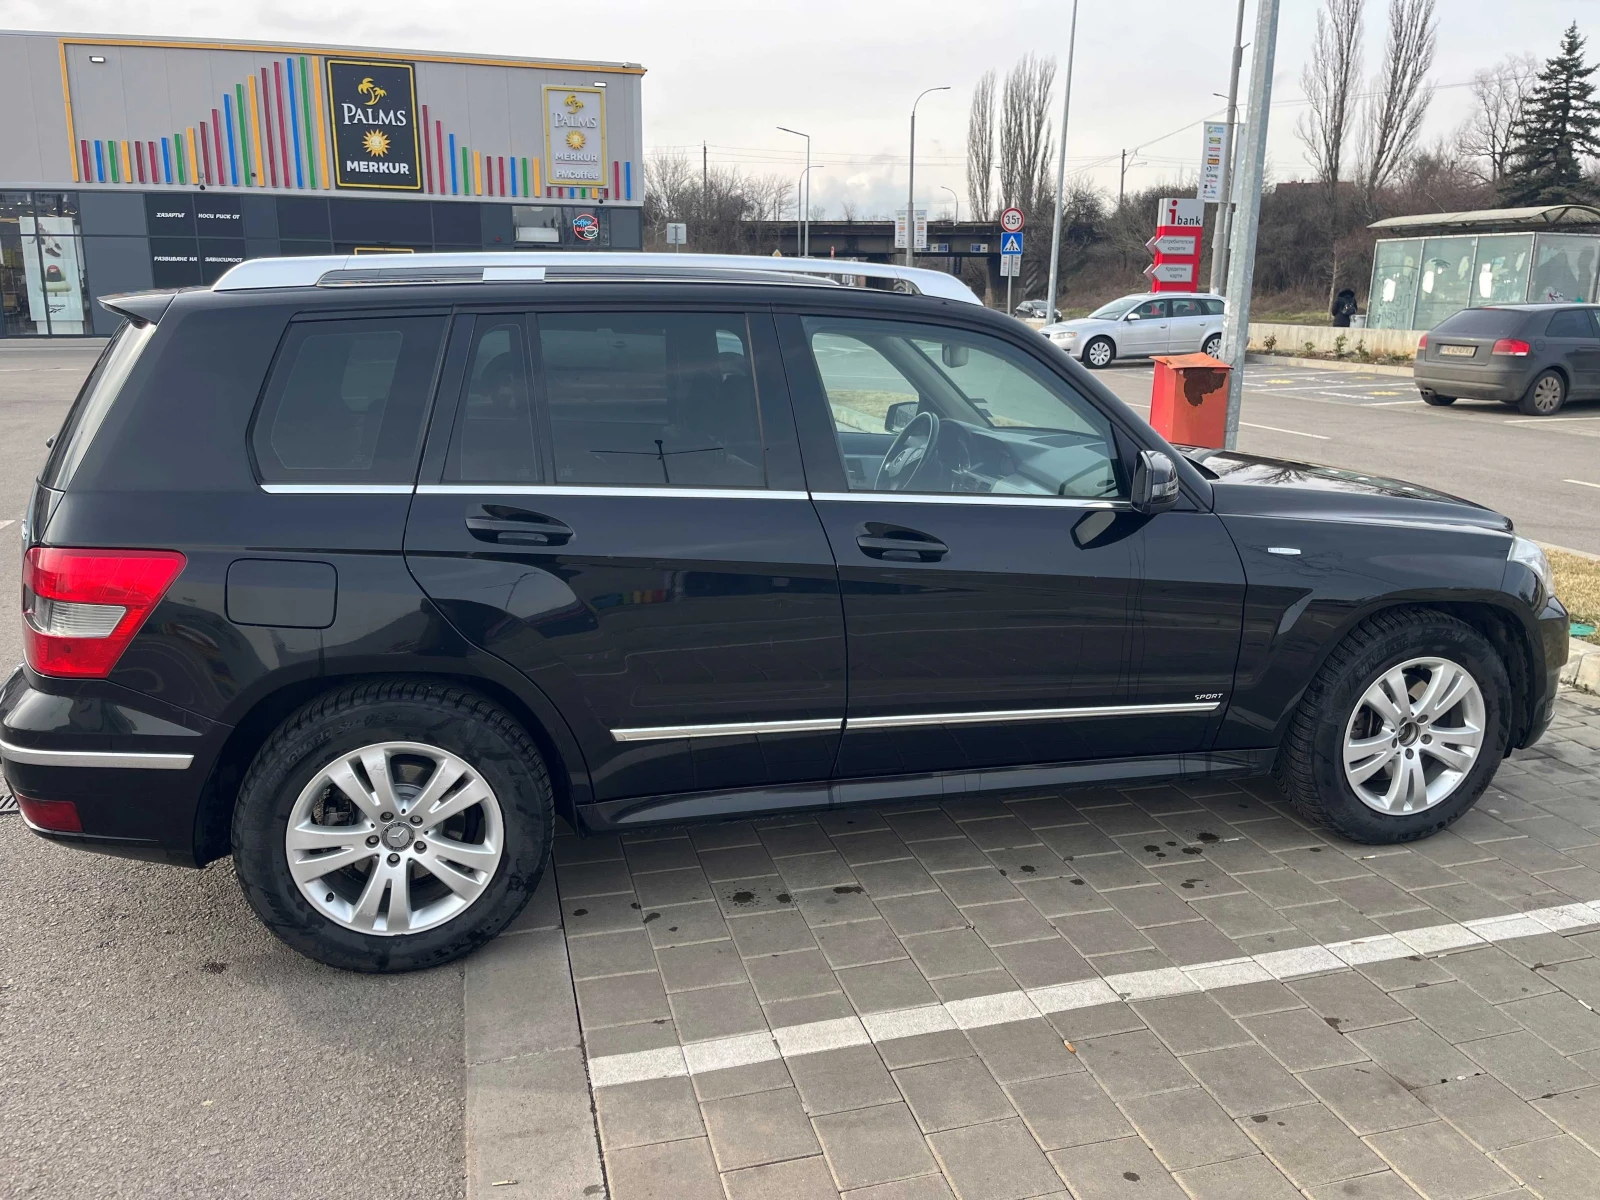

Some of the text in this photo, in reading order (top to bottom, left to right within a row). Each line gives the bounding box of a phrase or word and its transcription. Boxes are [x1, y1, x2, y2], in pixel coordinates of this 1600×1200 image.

[341, 103, 407, 126] PALMS
[553, 112, 597, 128] PALMS
[555, 152, 598, 162] MERKUR
[346, 160, 409, 174] MERKUR
[1194, 692, 1223, 701] SPORT
